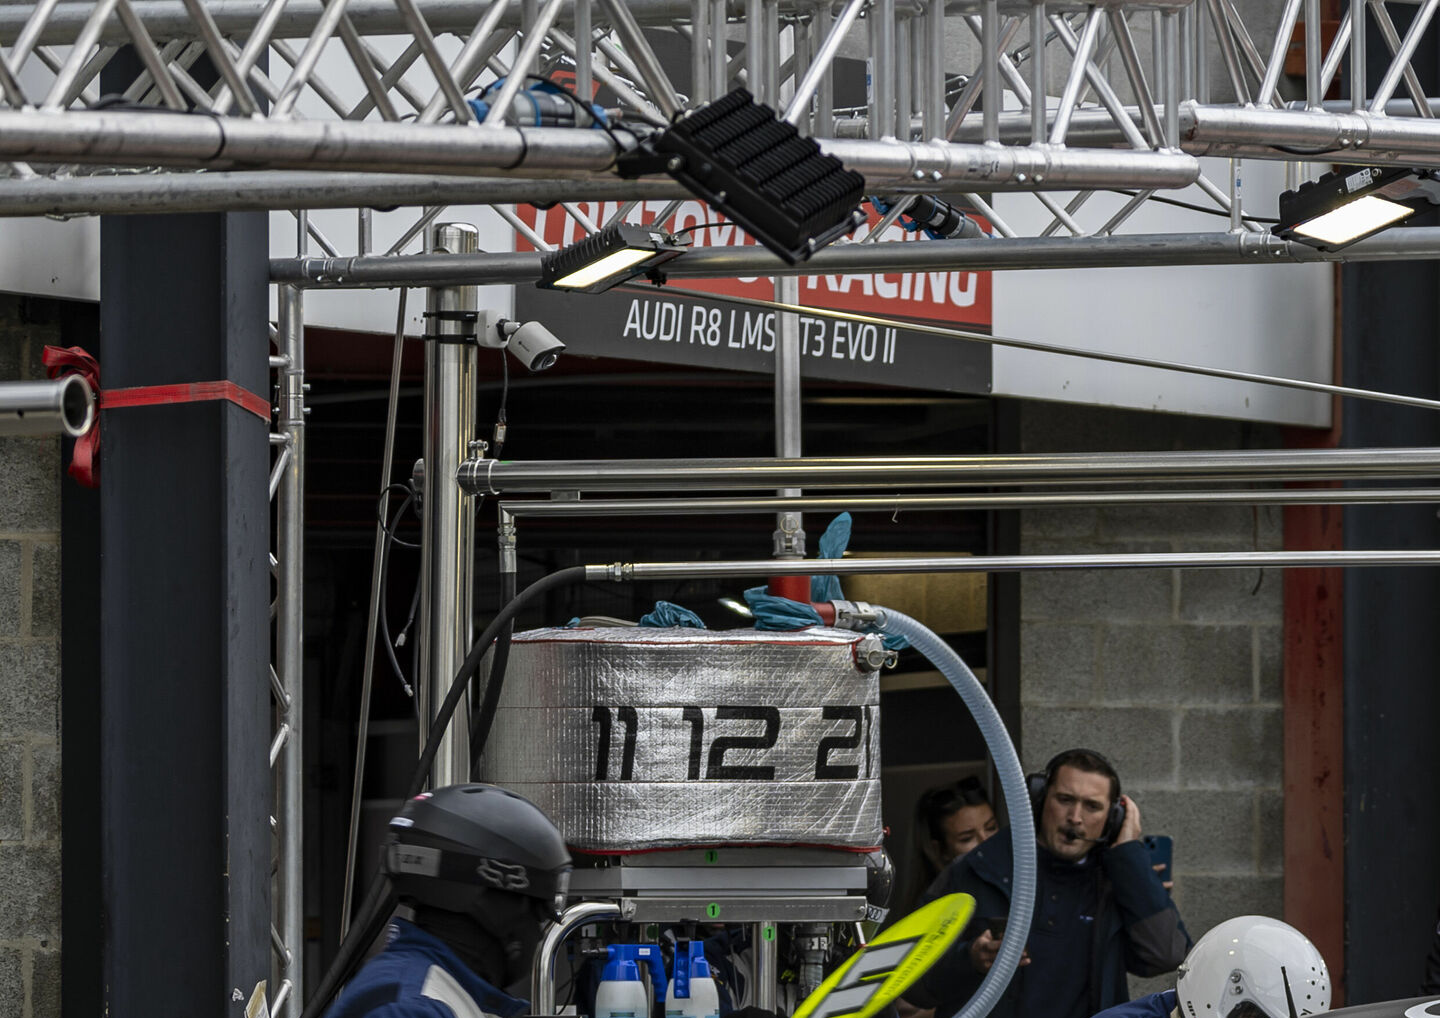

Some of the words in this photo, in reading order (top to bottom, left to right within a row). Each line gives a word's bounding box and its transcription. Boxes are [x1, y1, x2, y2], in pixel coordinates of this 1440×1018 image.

[624, 299, 683, 342] AUDI
[689, 305, 722, 347] R8
[728, 310, 776, 353] LMS
[801, 317, 826, 357] T3
[831, 320, 877, 364] EVO
[882, 327, 898, 364] II
[592, 705, 638, 781] 11
[682, 705, 781, 781] 12
